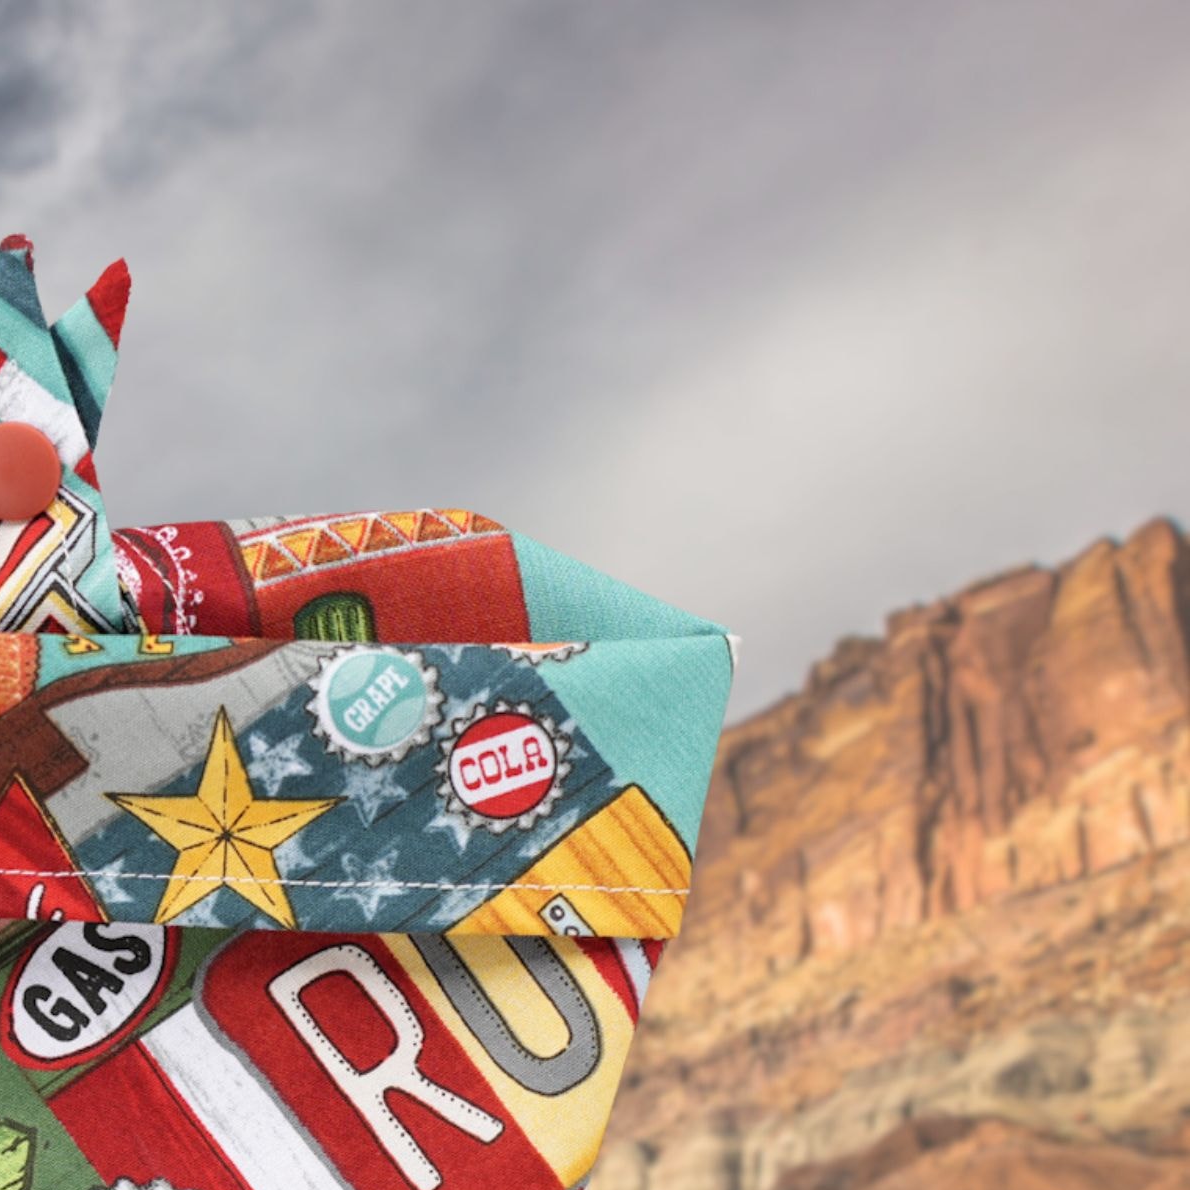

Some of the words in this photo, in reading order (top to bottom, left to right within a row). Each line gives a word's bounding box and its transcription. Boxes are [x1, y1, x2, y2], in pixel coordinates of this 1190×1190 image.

[342, 665, 410, 733] GRAPE
[459, 736, 548, 791] COLA
[22, 923, 152, 1042] GAS
